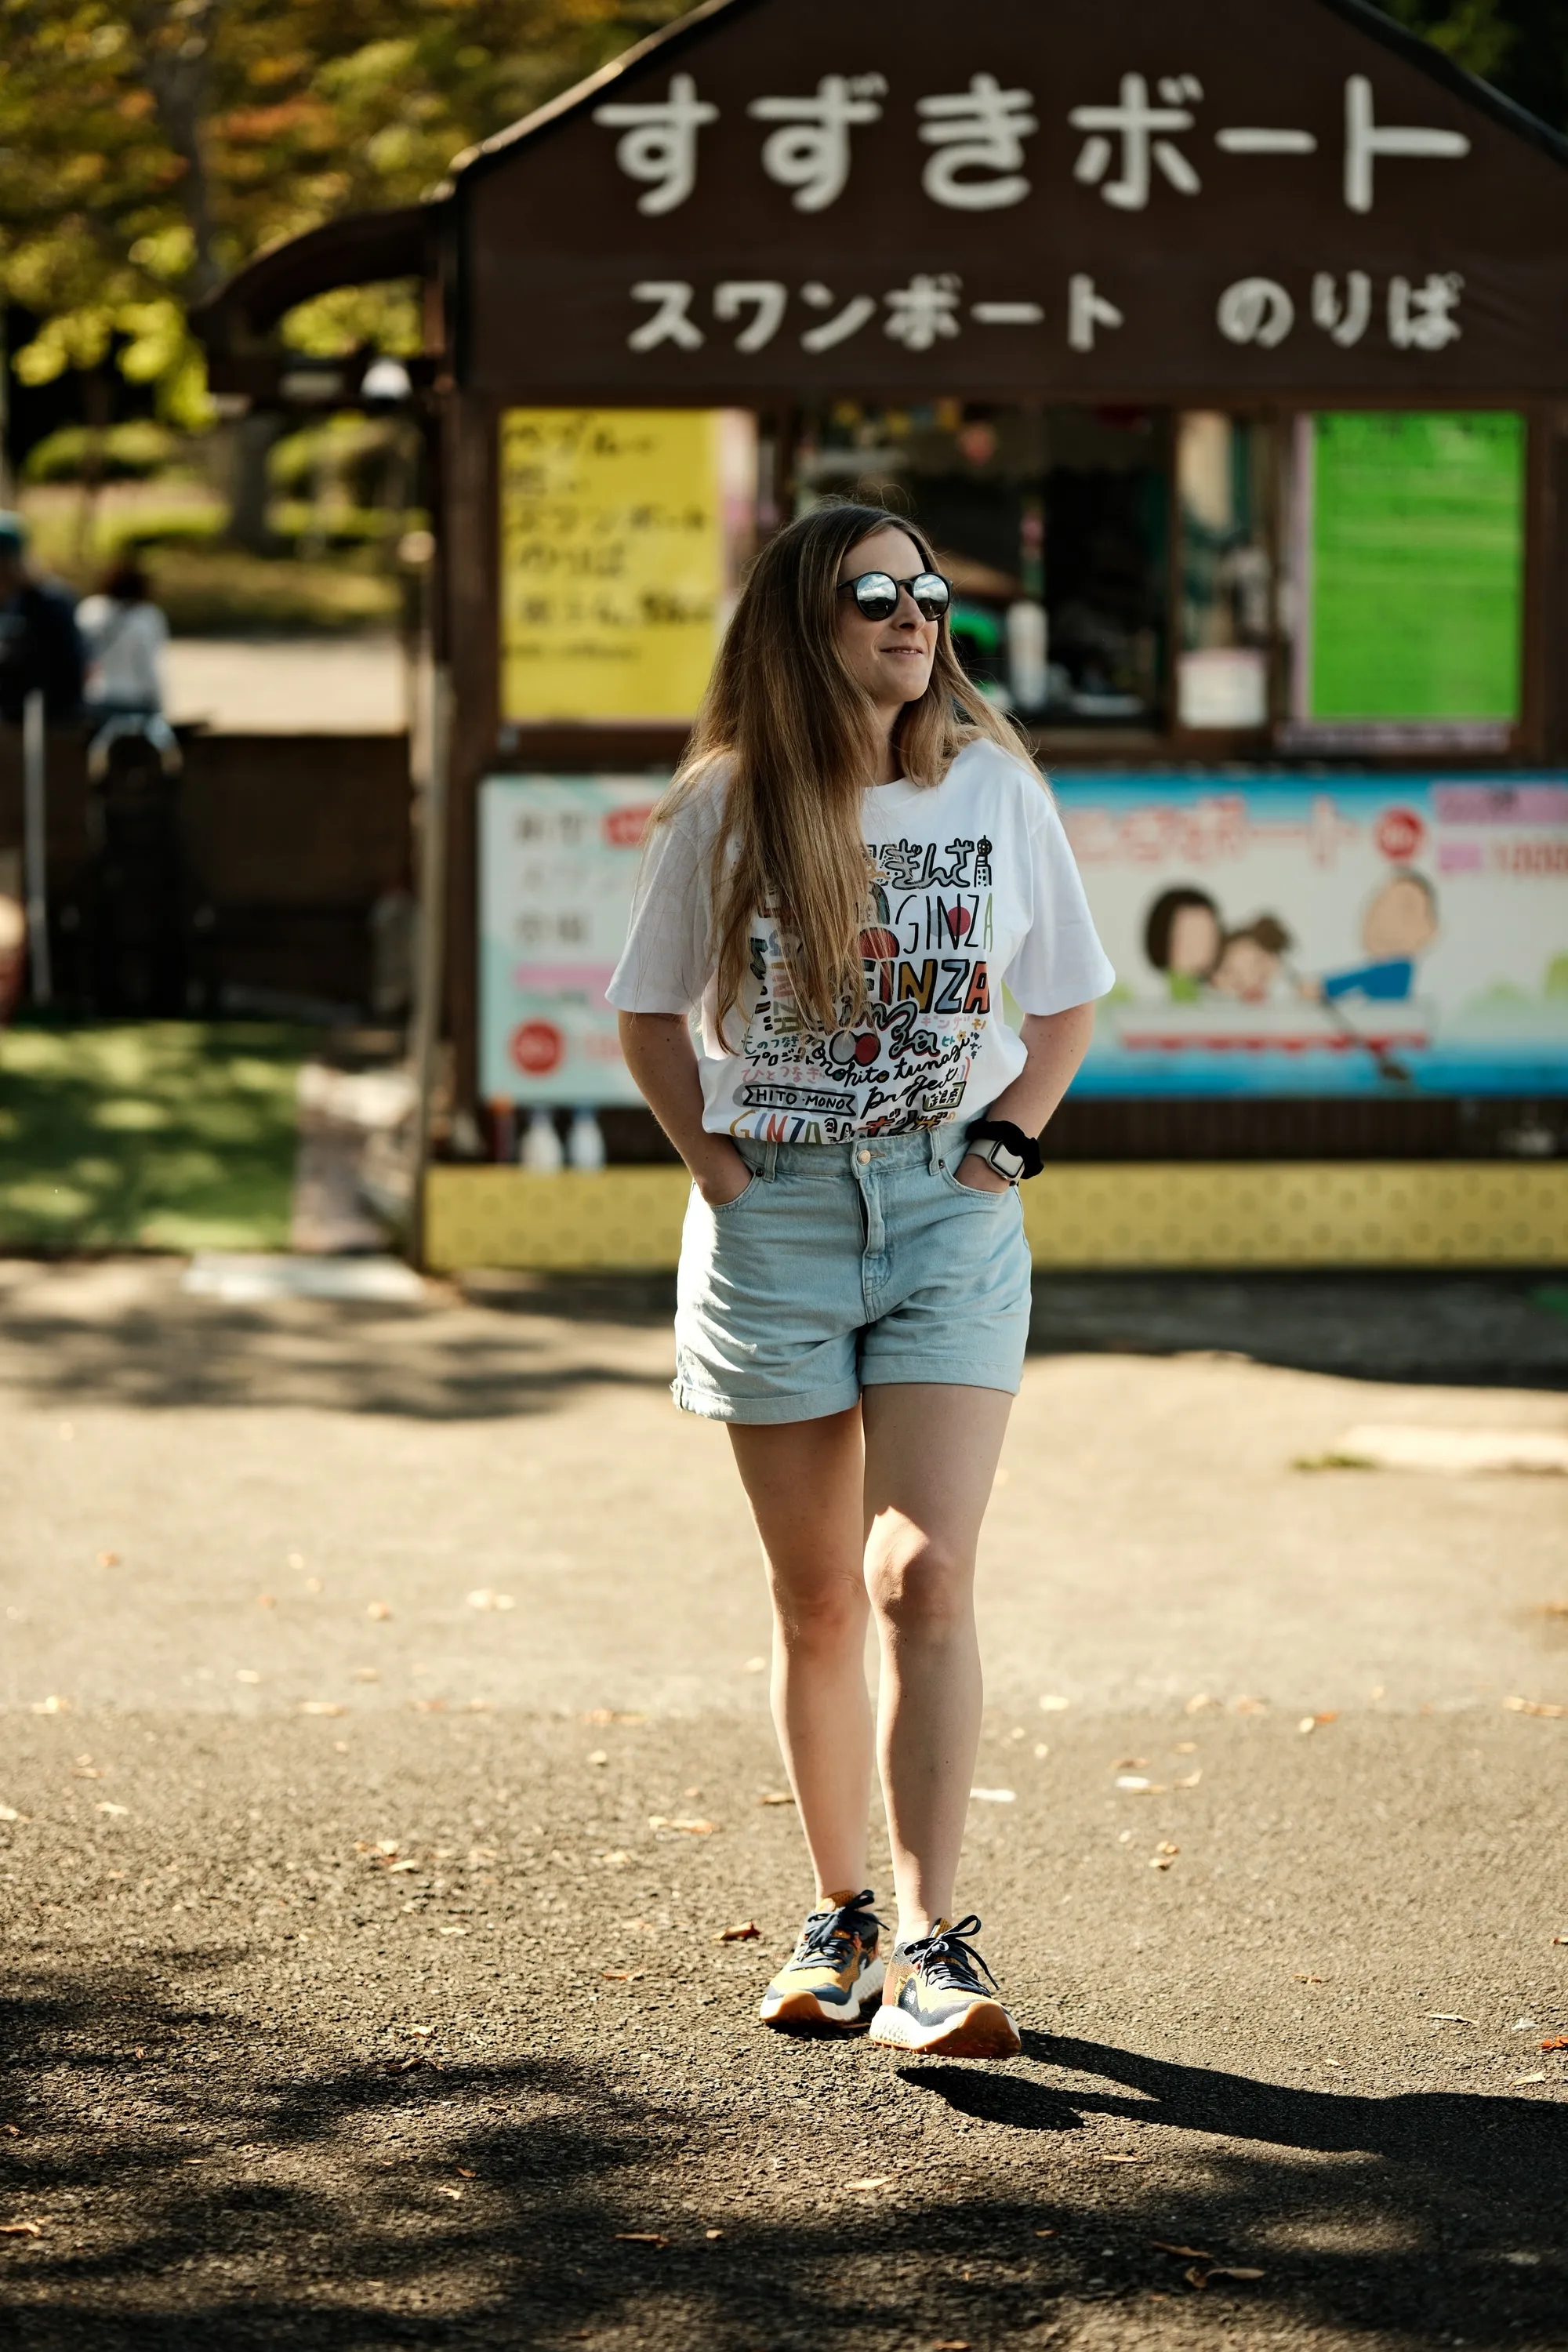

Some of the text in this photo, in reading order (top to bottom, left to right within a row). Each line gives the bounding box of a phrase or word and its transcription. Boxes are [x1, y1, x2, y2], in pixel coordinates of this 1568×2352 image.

[593, 72, 1471, 216] すずきボート
[628, 270, 1465, 353] スワンボート のりば
[895, 892, 994, 954] GINZA
